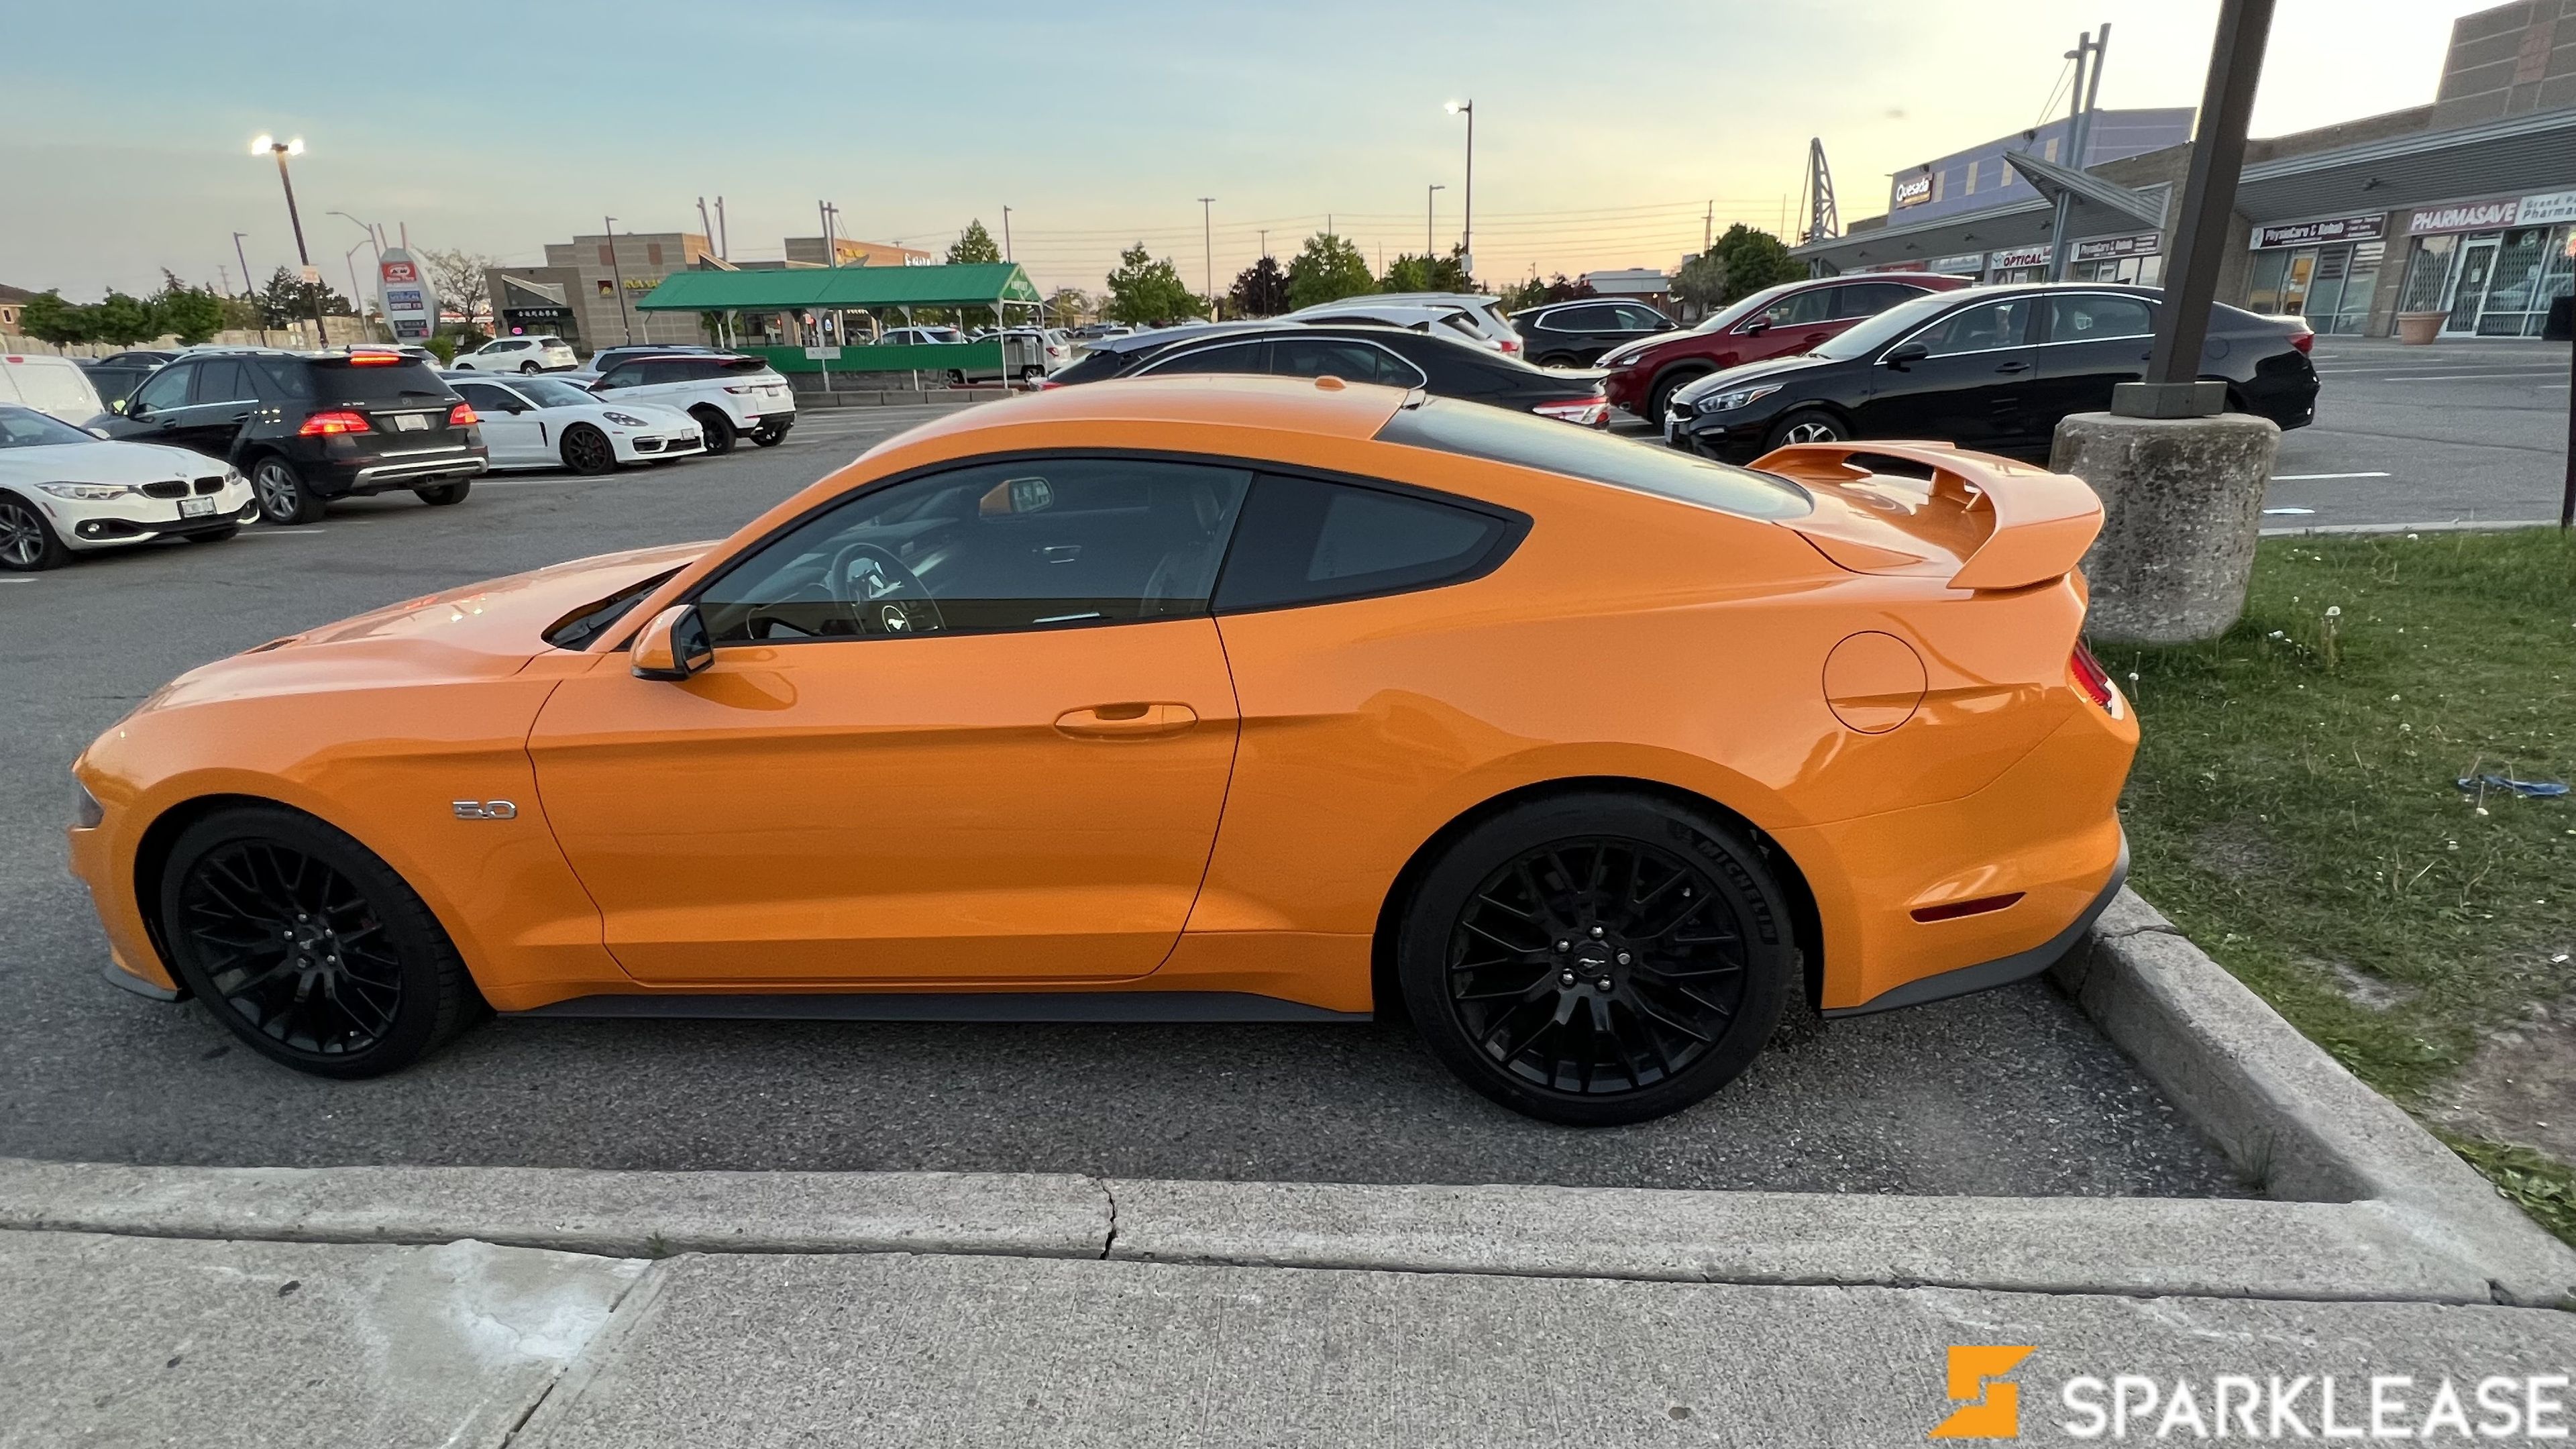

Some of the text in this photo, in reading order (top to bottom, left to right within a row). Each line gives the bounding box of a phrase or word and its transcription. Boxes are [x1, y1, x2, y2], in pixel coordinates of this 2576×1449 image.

[1896, 177, 1930, 202] Quesada
[2411, 202, 2517, 231] PHARMASAVE
[2004, 253, 2042, 267] OPTICAL
[452, 799, 517, 820] 5.0
[1695, 840, 1779, 945] MICHELIN
